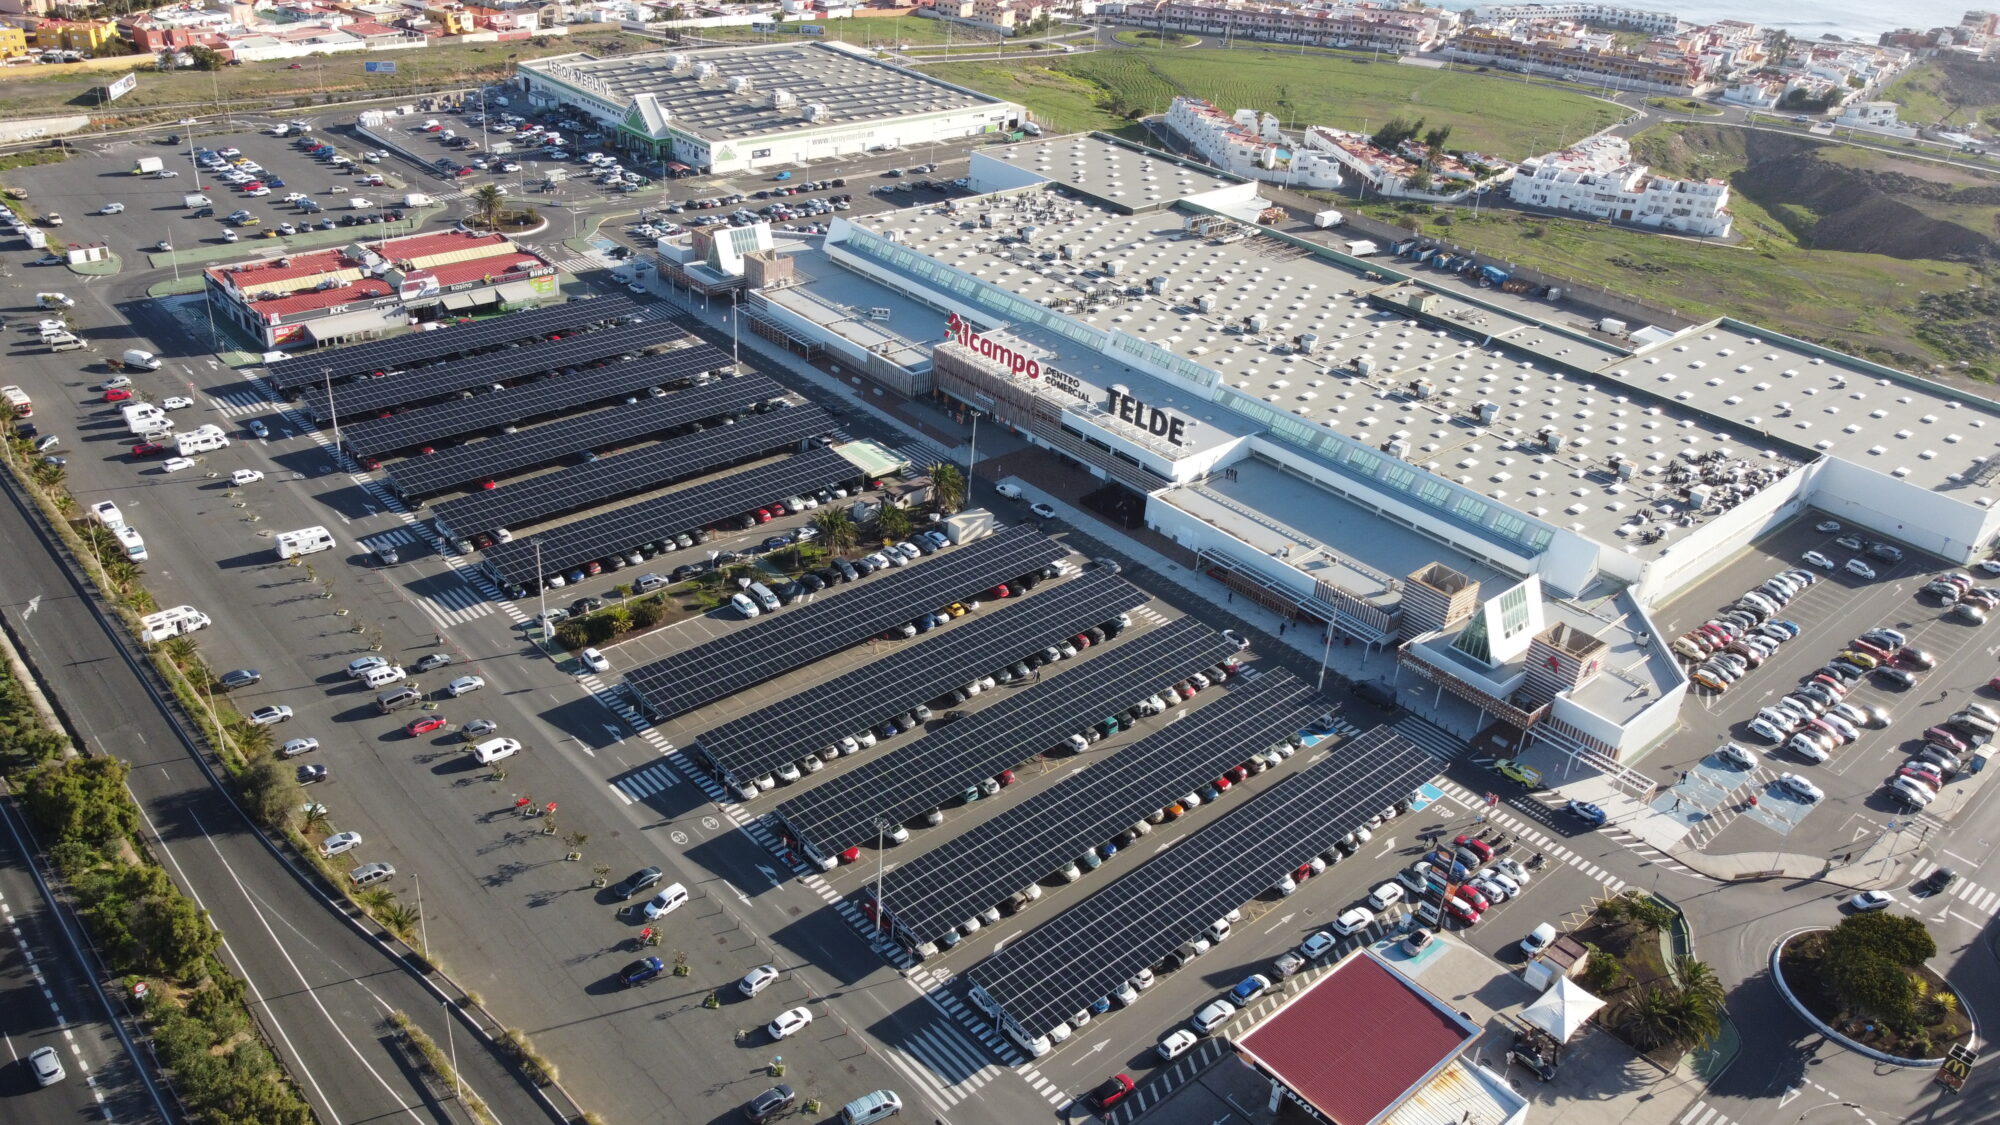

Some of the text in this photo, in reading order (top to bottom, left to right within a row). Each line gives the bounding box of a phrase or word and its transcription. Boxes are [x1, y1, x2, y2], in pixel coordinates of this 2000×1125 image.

[547, 60, 610, 96] LEROY MERLIN
[530, 267, 555, 278] BINGO
[329, 305, 349, 315] KFC
[1044, 375, 1091, 404] COMERCIAL
[1045, 366, 1080, 388] CENTRO
[1106, 386, 1185, 448] TELDE
[1269, 1077, 1321, 1120] REPSOL
